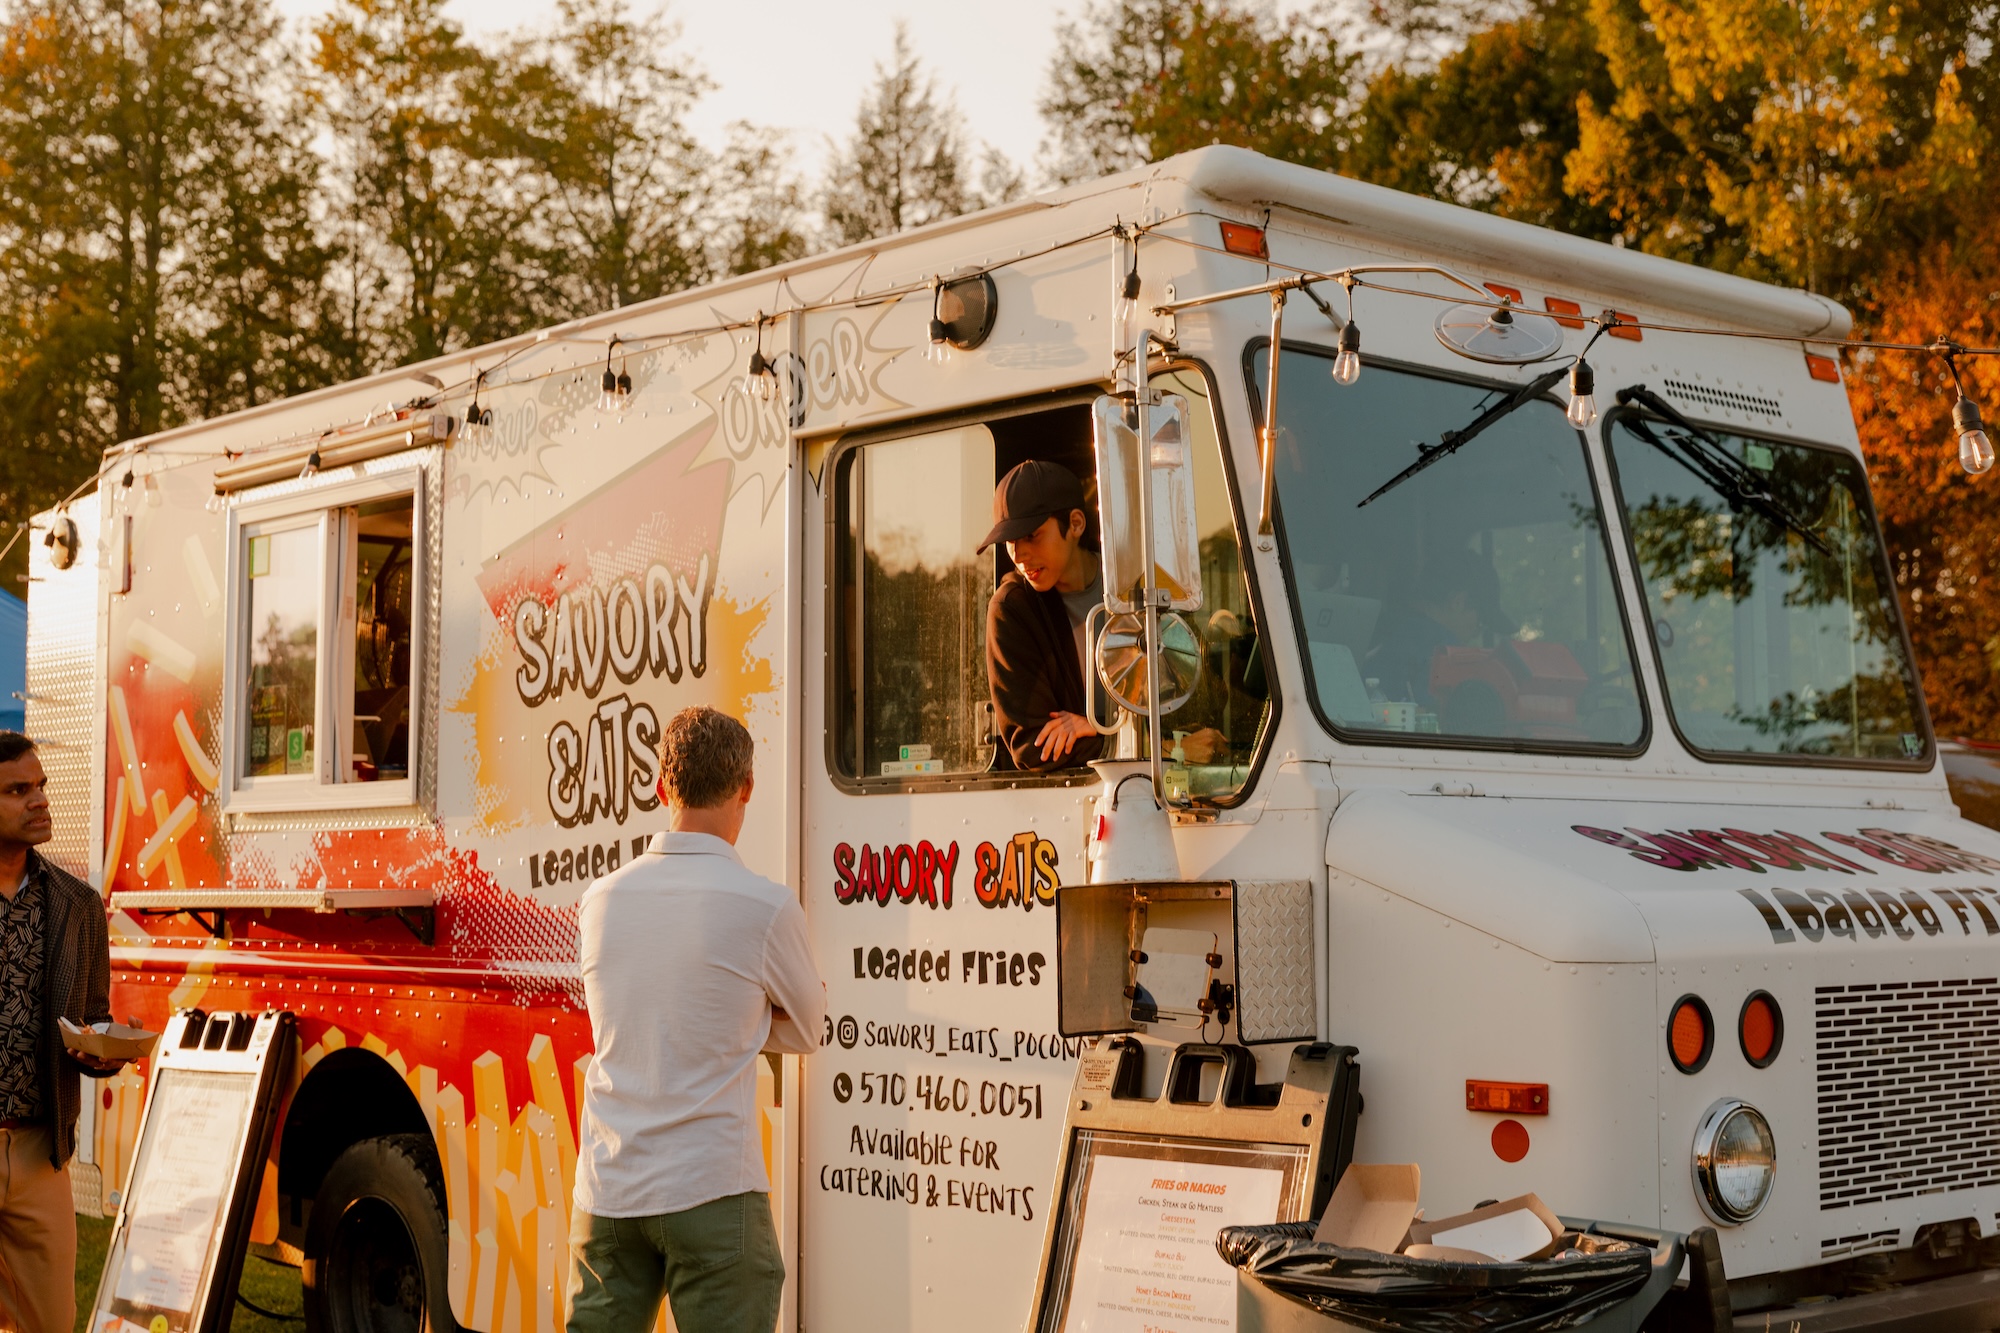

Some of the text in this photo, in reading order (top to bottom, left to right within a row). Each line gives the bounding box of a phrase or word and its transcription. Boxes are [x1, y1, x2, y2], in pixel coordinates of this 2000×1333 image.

[516, 554, 712, 707] SAVORY
[548, 692, 661, 829] EATS
[530, 839, 620, 889] Loaded
[833, 831, 1062, 912] SAVORY EATS
[1570, 825, 1878, 875] SAVORY
[1736, 887, 1944, 944] Loaded
[853, 946, 1046, 987] Loaded Fries
[861, 1072, 1043, 1119] 570.460.0051
[926, 1174, 941, 1207] &
[1151, 1178, 1227, 1195] FRIES OR NACHOS
